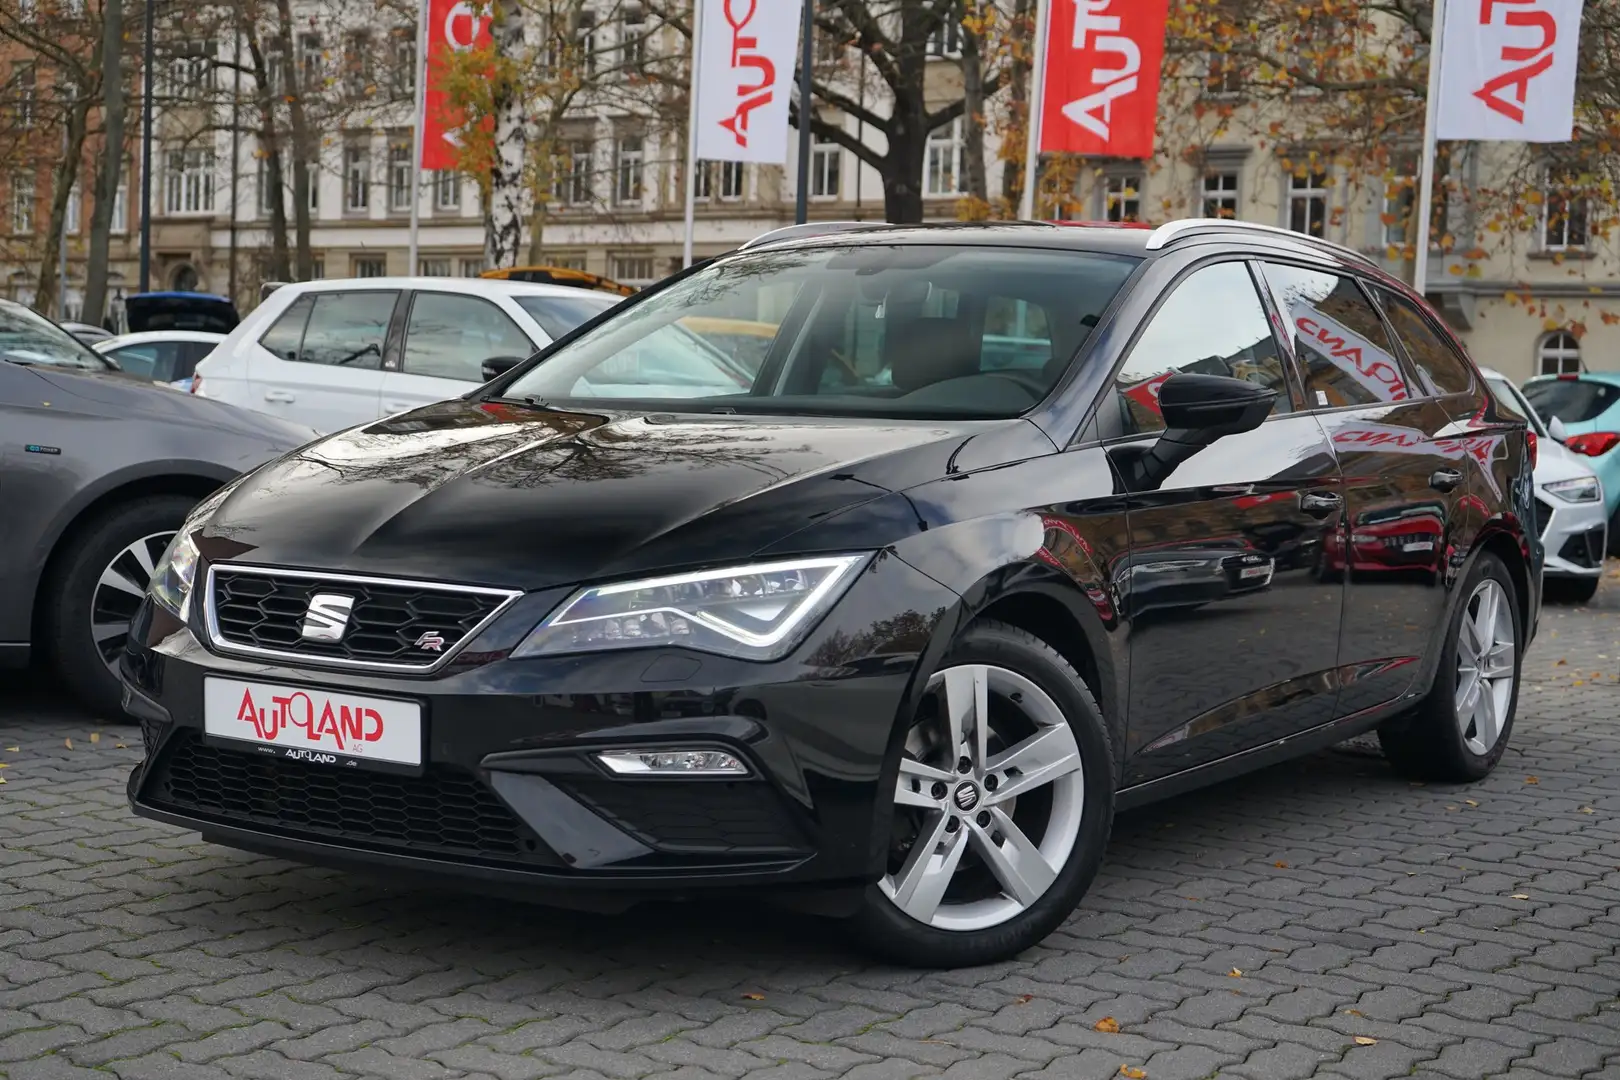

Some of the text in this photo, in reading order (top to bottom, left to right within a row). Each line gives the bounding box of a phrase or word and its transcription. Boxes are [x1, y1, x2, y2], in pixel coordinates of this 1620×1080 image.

[1062, 0, 1142, 143] AUT
[414, 631, 445, 651] FR
[237, 687, 384, 750] AUTOLAND
[285, 748, 337, 764] AUTOLAND
[353, 744, 363, 754] AG
